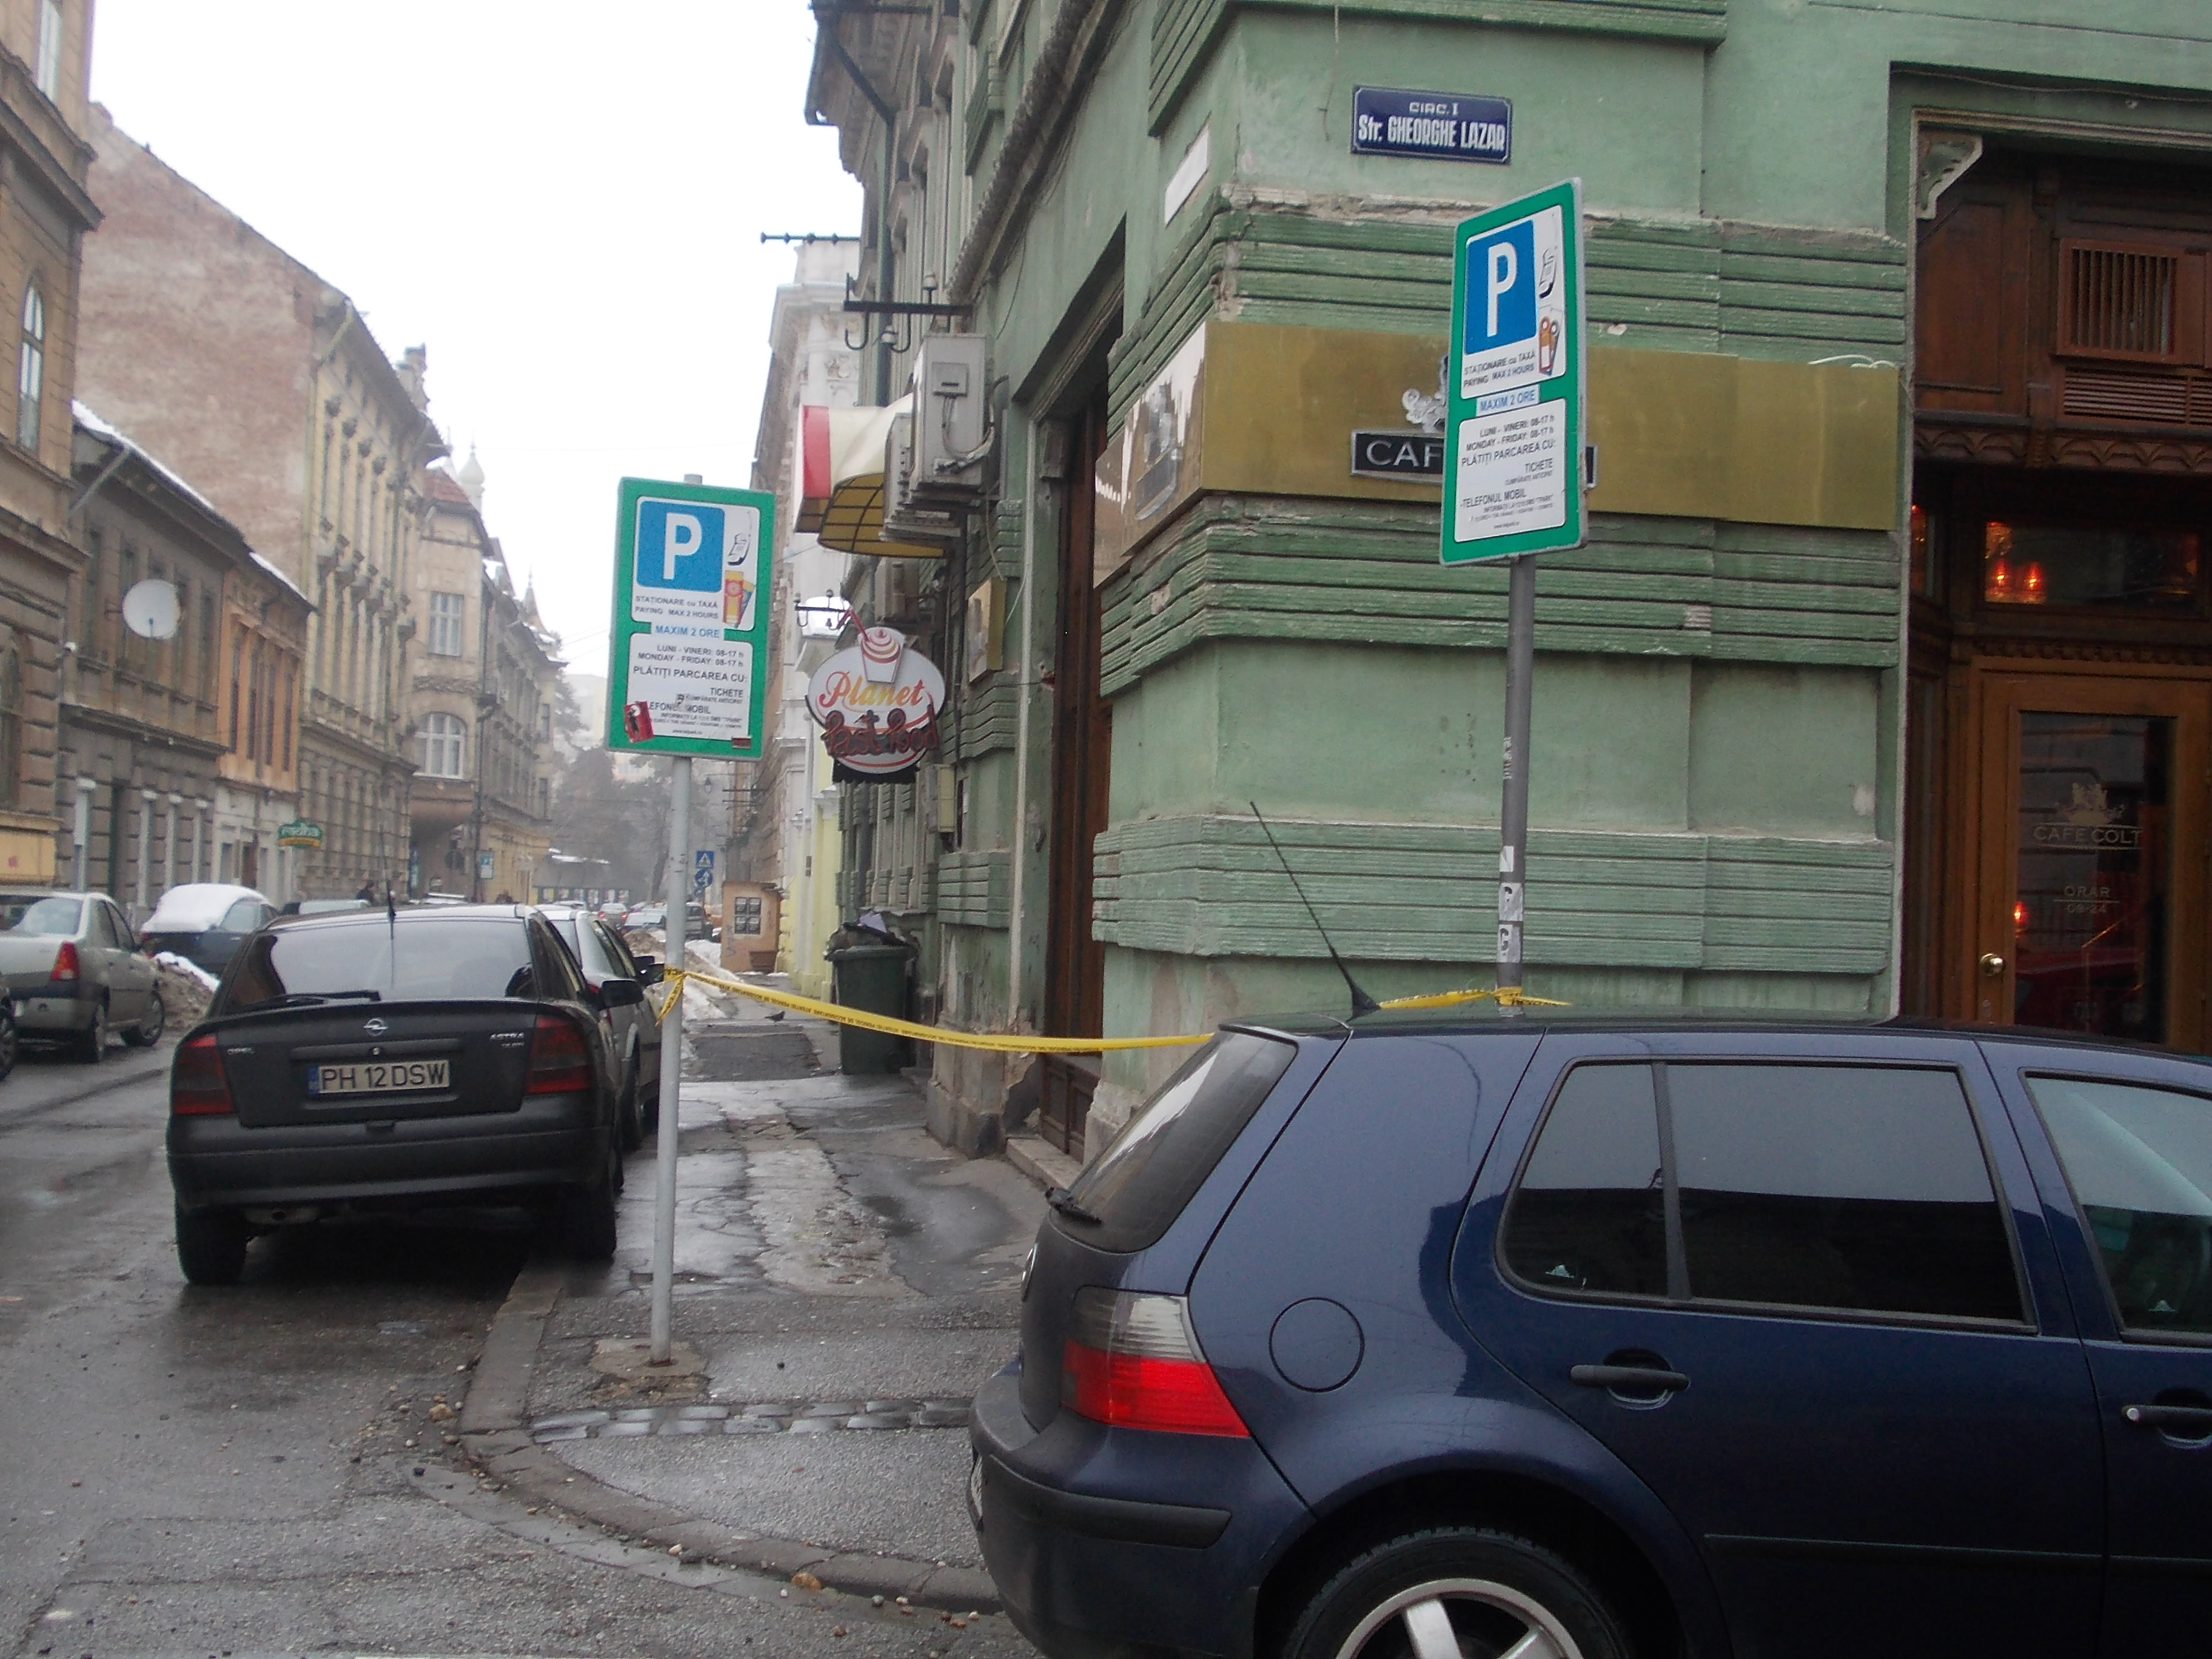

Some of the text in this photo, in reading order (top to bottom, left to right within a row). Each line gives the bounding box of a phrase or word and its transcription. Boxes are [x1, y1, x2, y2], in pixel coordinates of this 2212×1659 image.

[1358, 114, 1382, 141] Str.
[1387, 115, 1456, 147] GHEORGHE
[1487, 242, 1517, 337] P
[1464, 375, 1488, 388] PAYING
[1492, 370, 1505, 380] MAX
[1512, 364, 1534, 375] HOURS
[1480, 390, 1535, 411] MAXIM 2 ORE
[1480, 426, 1497, 437] LUNI
[1466, 437, 1496, 451] MONDAY
[1366, 440, 1444, 468] CAF
[1493, 443, 1540, 461] PARCAREA
[1525, 458, 1553, 472] TICHETE
[1504, 488, 1527, 501] MOBIL
[663, 512, 702, 580] P
[635, 606, 663, 615] PAYING
[655, 625, 720, 638] MAXIM 2 ORE
[638, 652, 674, 662] MONDAY
[673, 669, 728, 681] PARCAREA
[709, 688, 743, 697] TICHETE
[819, 671, 925, 708] Planet
[2064, 885, 2110, 897] ORAR
[321, 1068, 356, 1090] PH
[364, 1066, 386, 1087] 12
[391, 1063, 447, 1087] DSW
